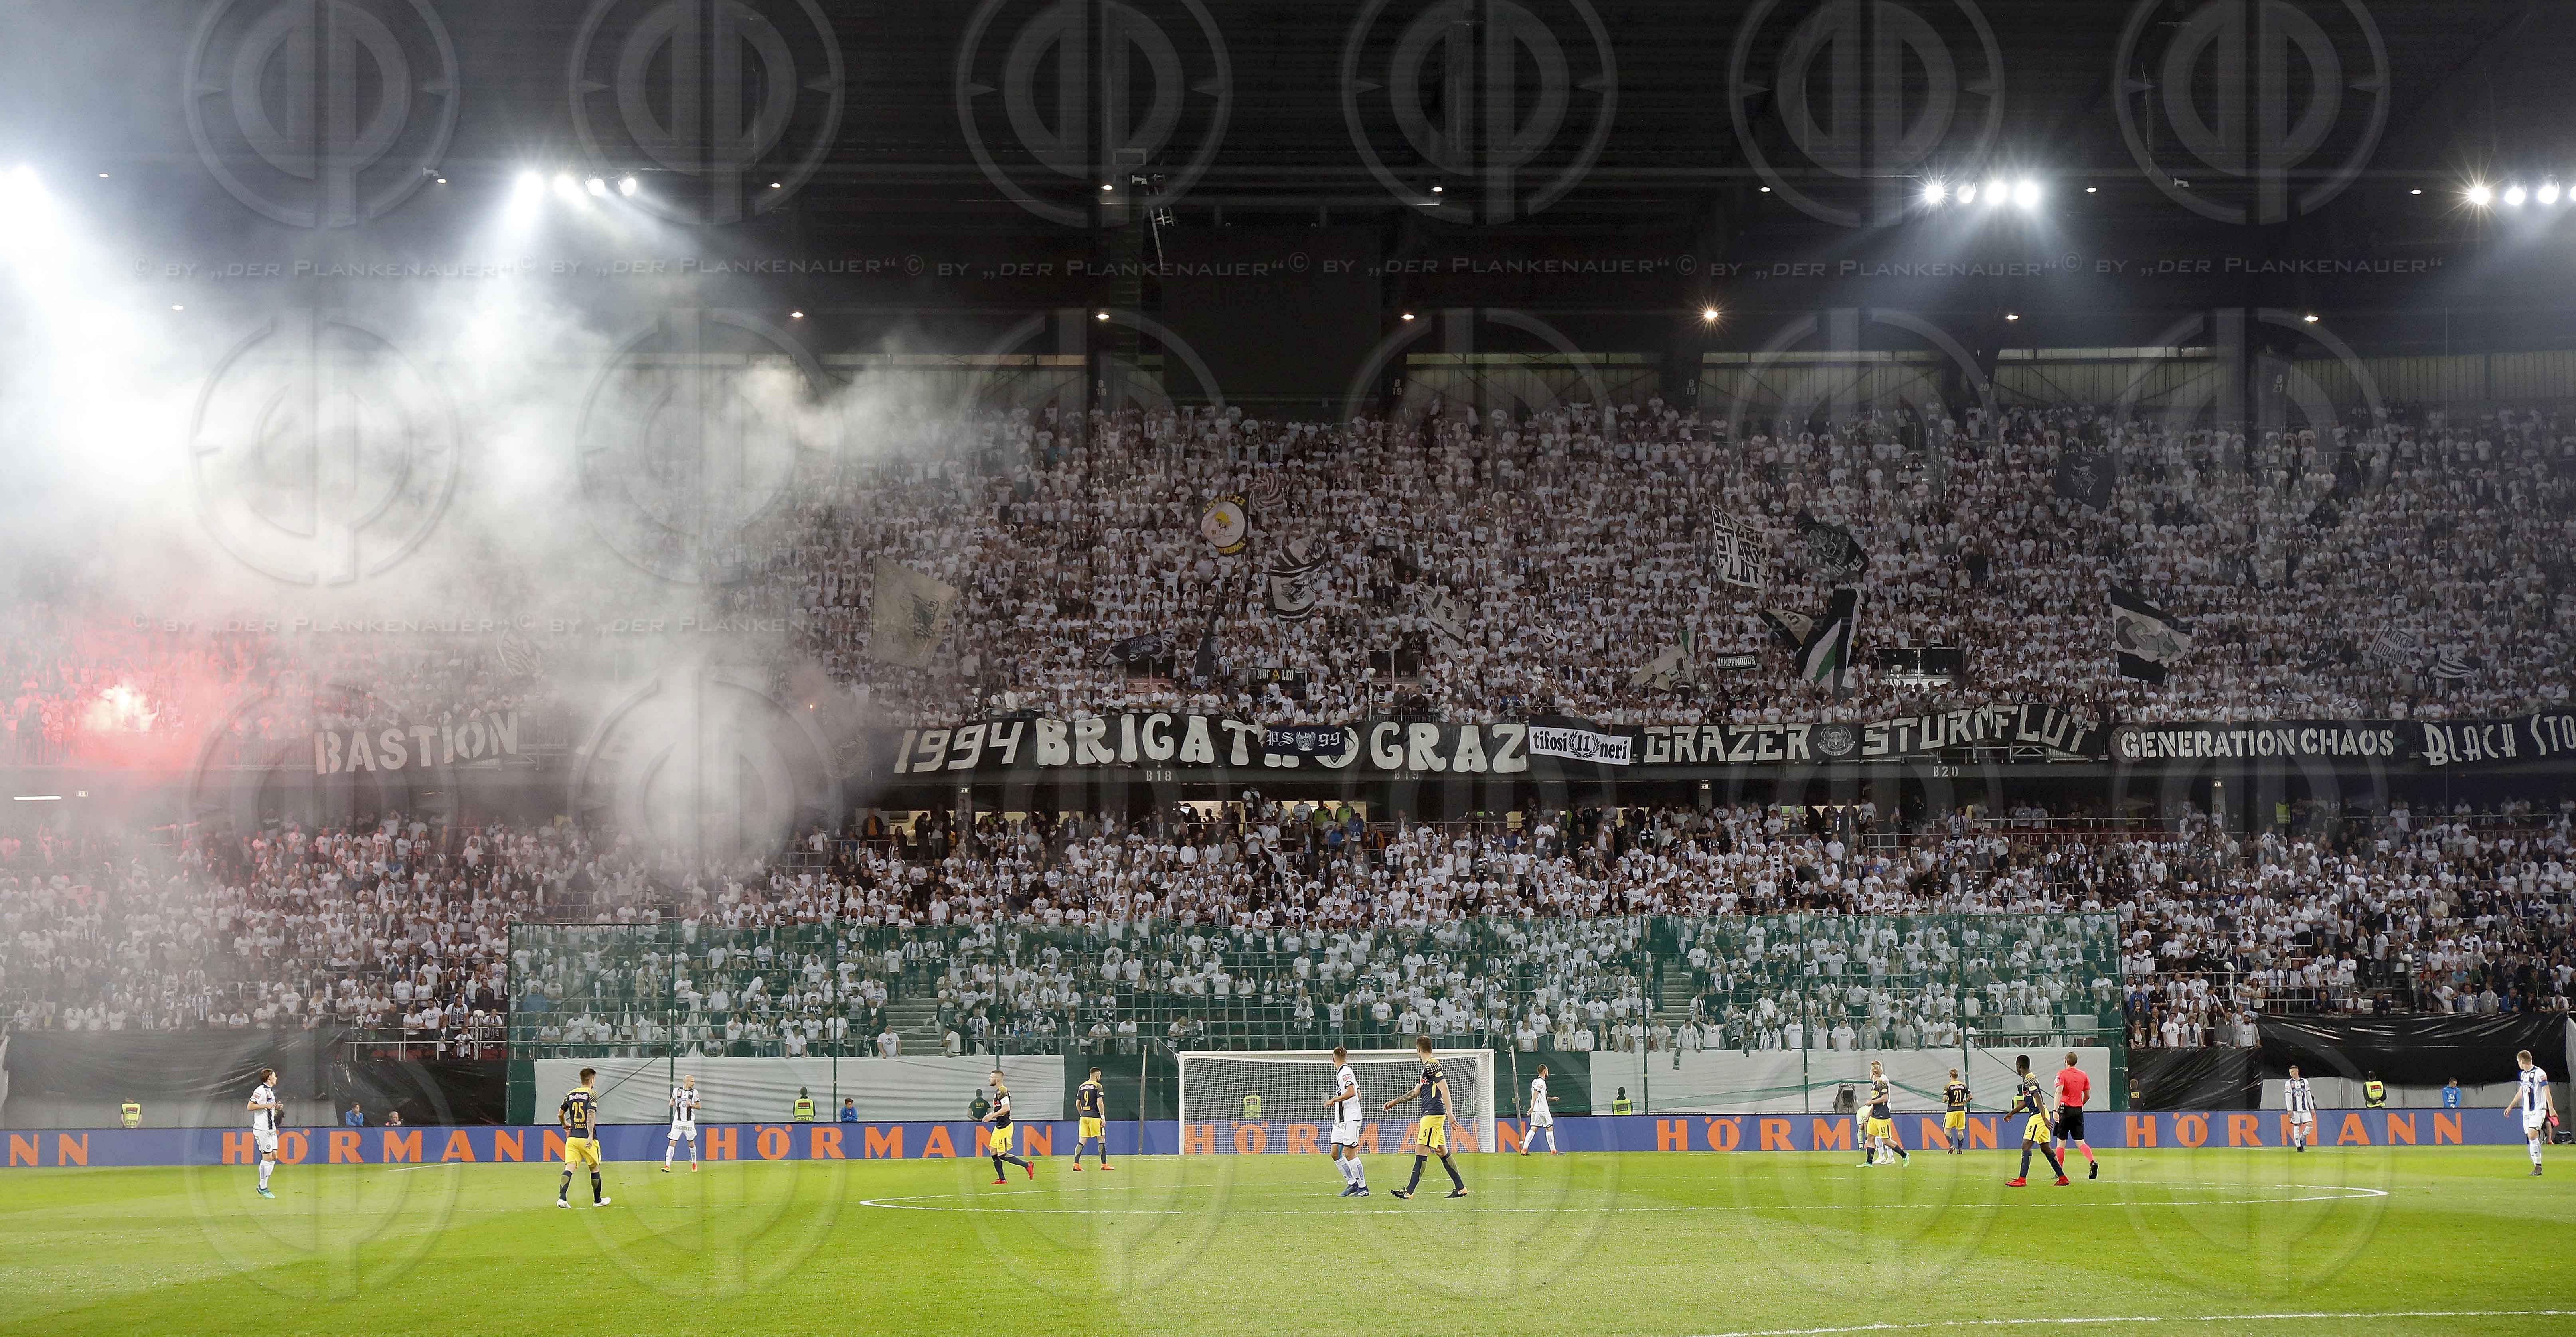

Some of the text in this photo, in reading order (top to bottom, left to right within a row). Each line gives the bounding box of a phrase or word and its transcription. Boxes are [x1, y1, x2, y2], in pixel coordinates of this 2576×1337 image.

[1717, 656, 1756, 667] KAMPFMODUS
[1318, 731, 1341, 747] 99
[1644, 701, 2098, 763] GRAZER STURMFLUT
[894, 721, 1024, 773] 1994
[1370, 721, 1527, 773] GRAZ
[1533, 730, 1567, 753] tifosi
[1599, 740, 1628, 760] neri
[2120, 728, 2394, 758] GENERATION CHAOS
[2422, 722, 2516, 766] BLACK
[1084, 1091, 1089, 1106] 9
[1954, 1089, 1962, 1103] 21
[571, 1102, 585, 1123] 25
[1423, 1129, 1427, 1137] 5
